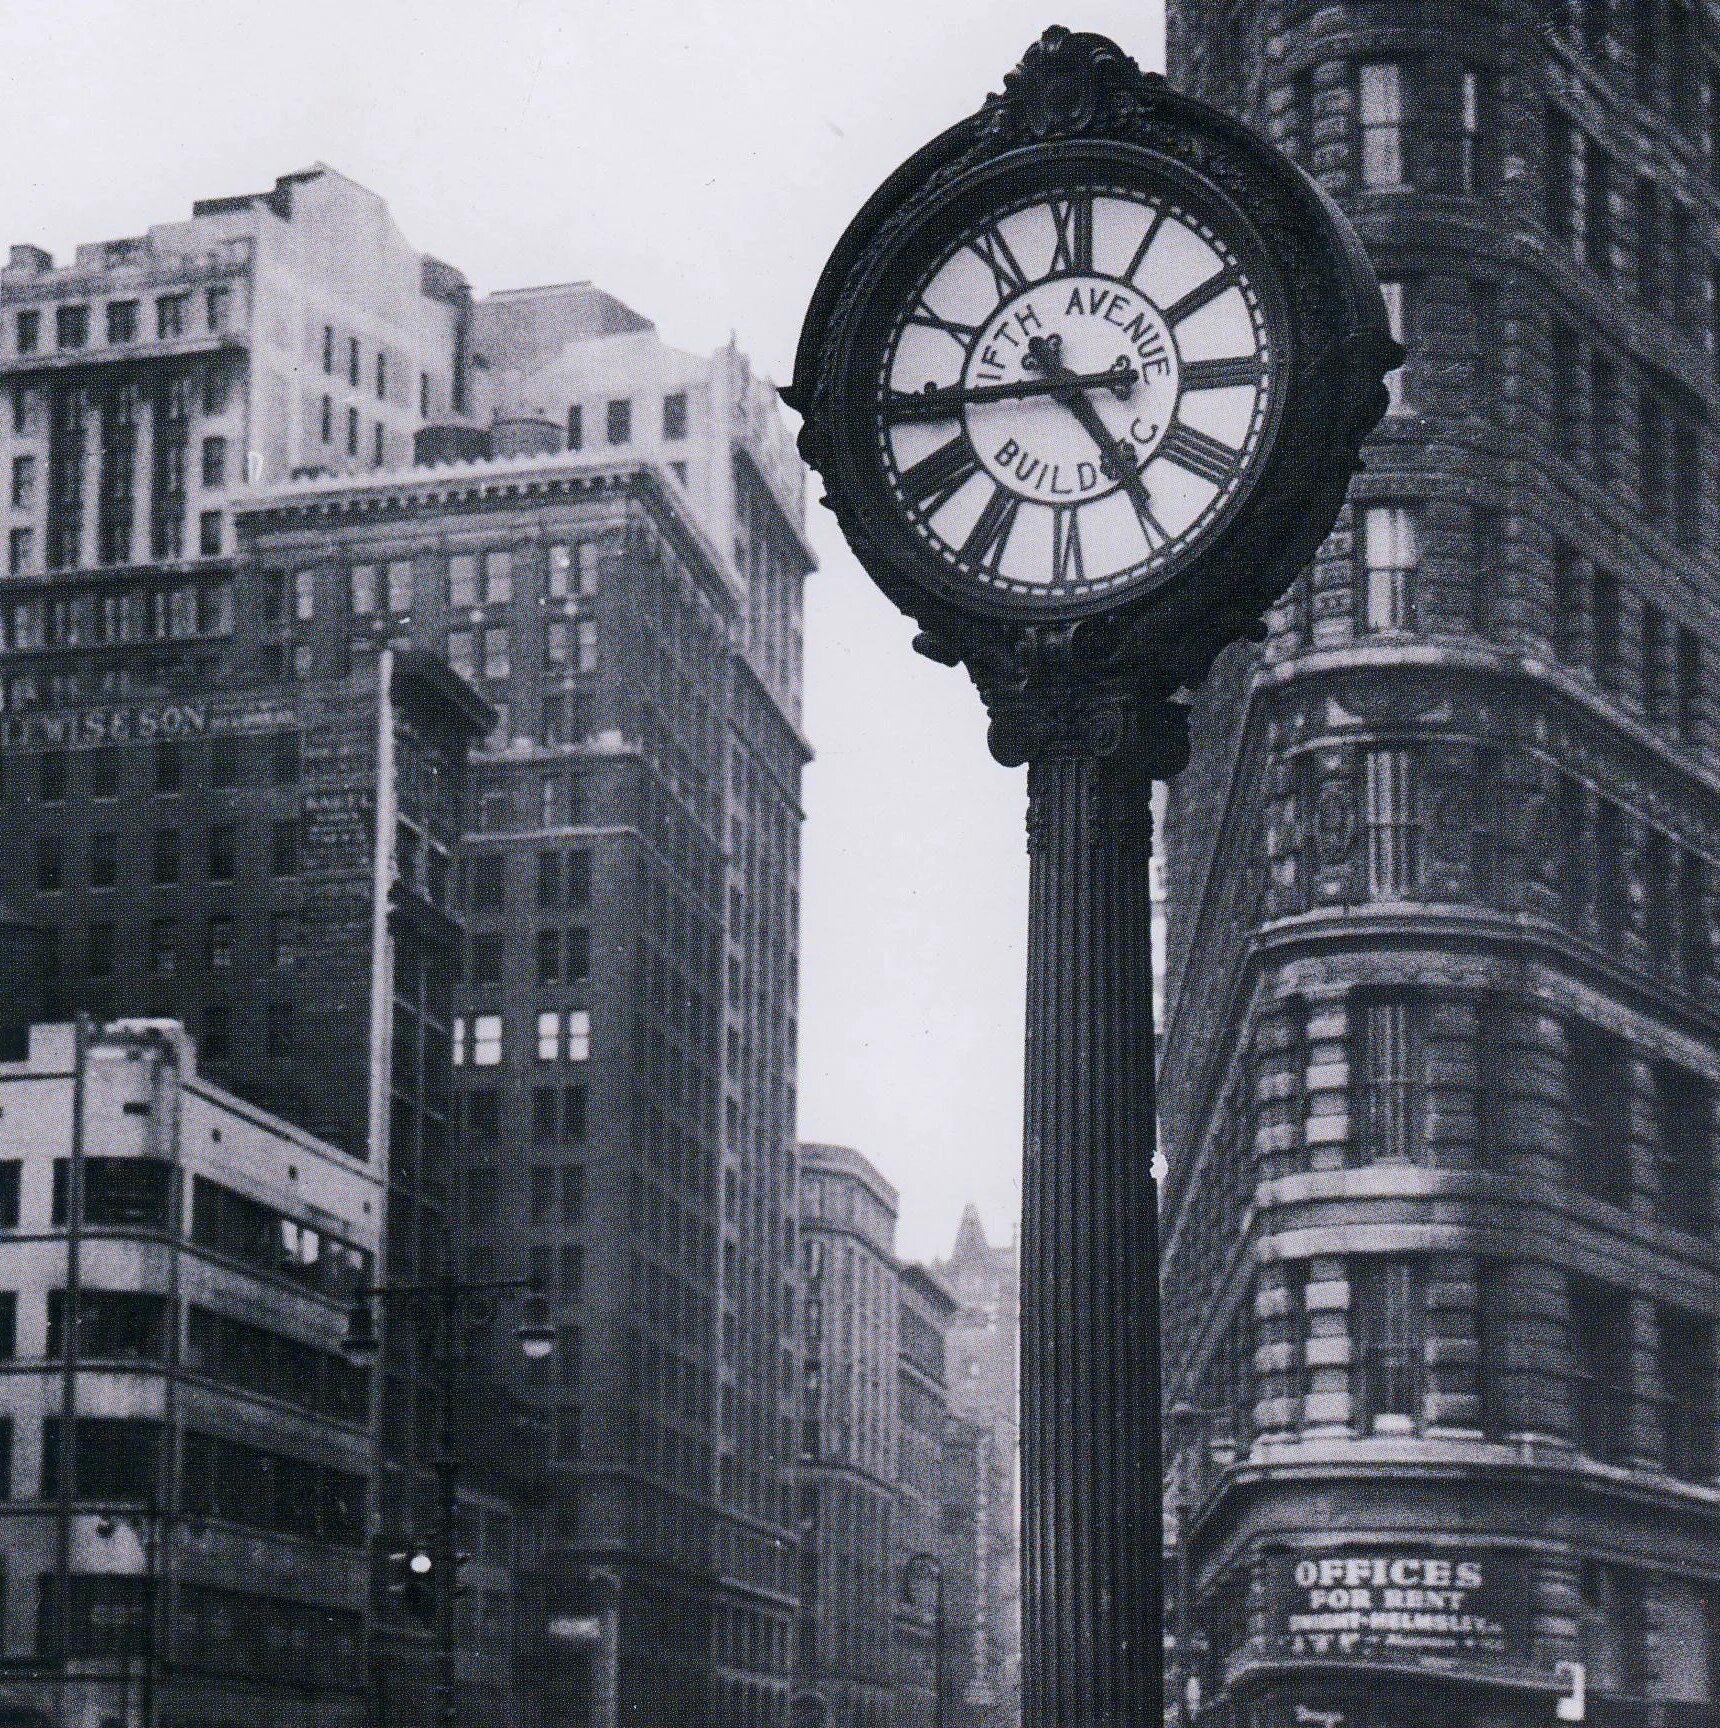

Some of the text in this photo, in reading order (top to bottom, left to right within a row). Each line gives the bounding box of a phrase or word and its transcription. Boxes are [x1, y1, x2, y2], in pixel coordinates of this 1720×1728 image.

[976, 287, 1171, 385] IFTH AVENUE
[993, 417, 1158, 495] BUILDG
[1295, 1559, 1483, 1588] OFFICES
[1310, 1589, 1466, 1610] FOR RENT
